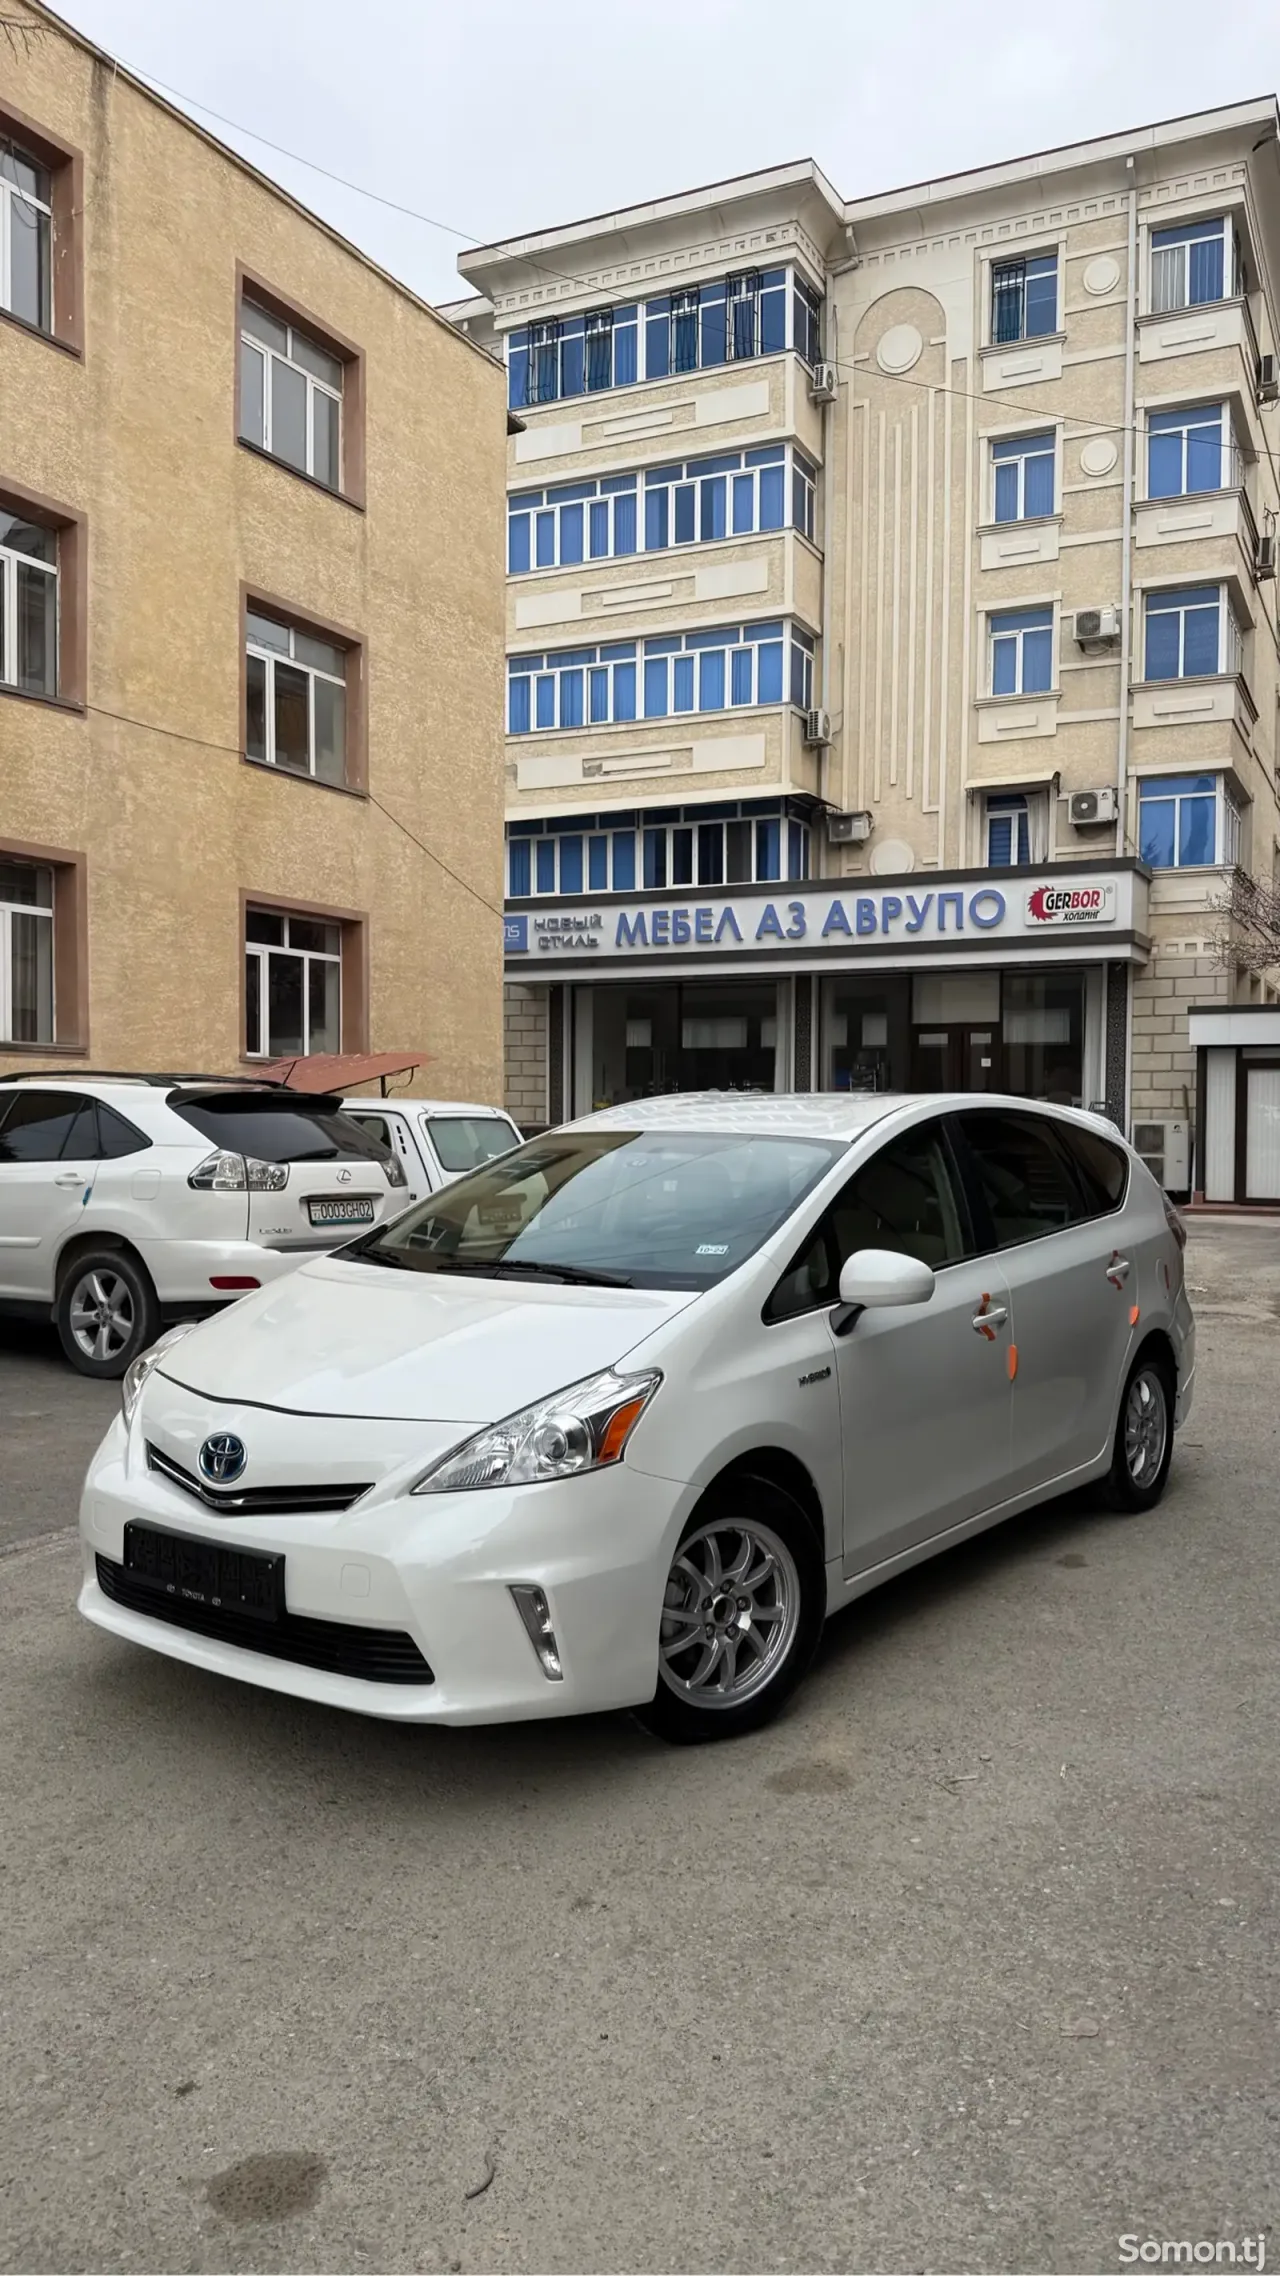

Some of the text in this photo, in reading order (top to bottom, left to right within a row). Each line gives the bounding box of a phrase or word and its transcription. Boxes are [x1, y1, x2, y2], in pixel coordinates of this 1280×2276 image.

[1045, 890, 1101, 911] GERBOR
[534, 914, 604, 932] НОВЫЙ
[615, 889, 1006, 947] МЕБЕЛ АЗ АВРУПО
[538, 933, 600, 950] СТИЛЬ
[798, 1366, 831, 1388] HYBRID
[182, 1588, 205, 1601] TOYOTA
